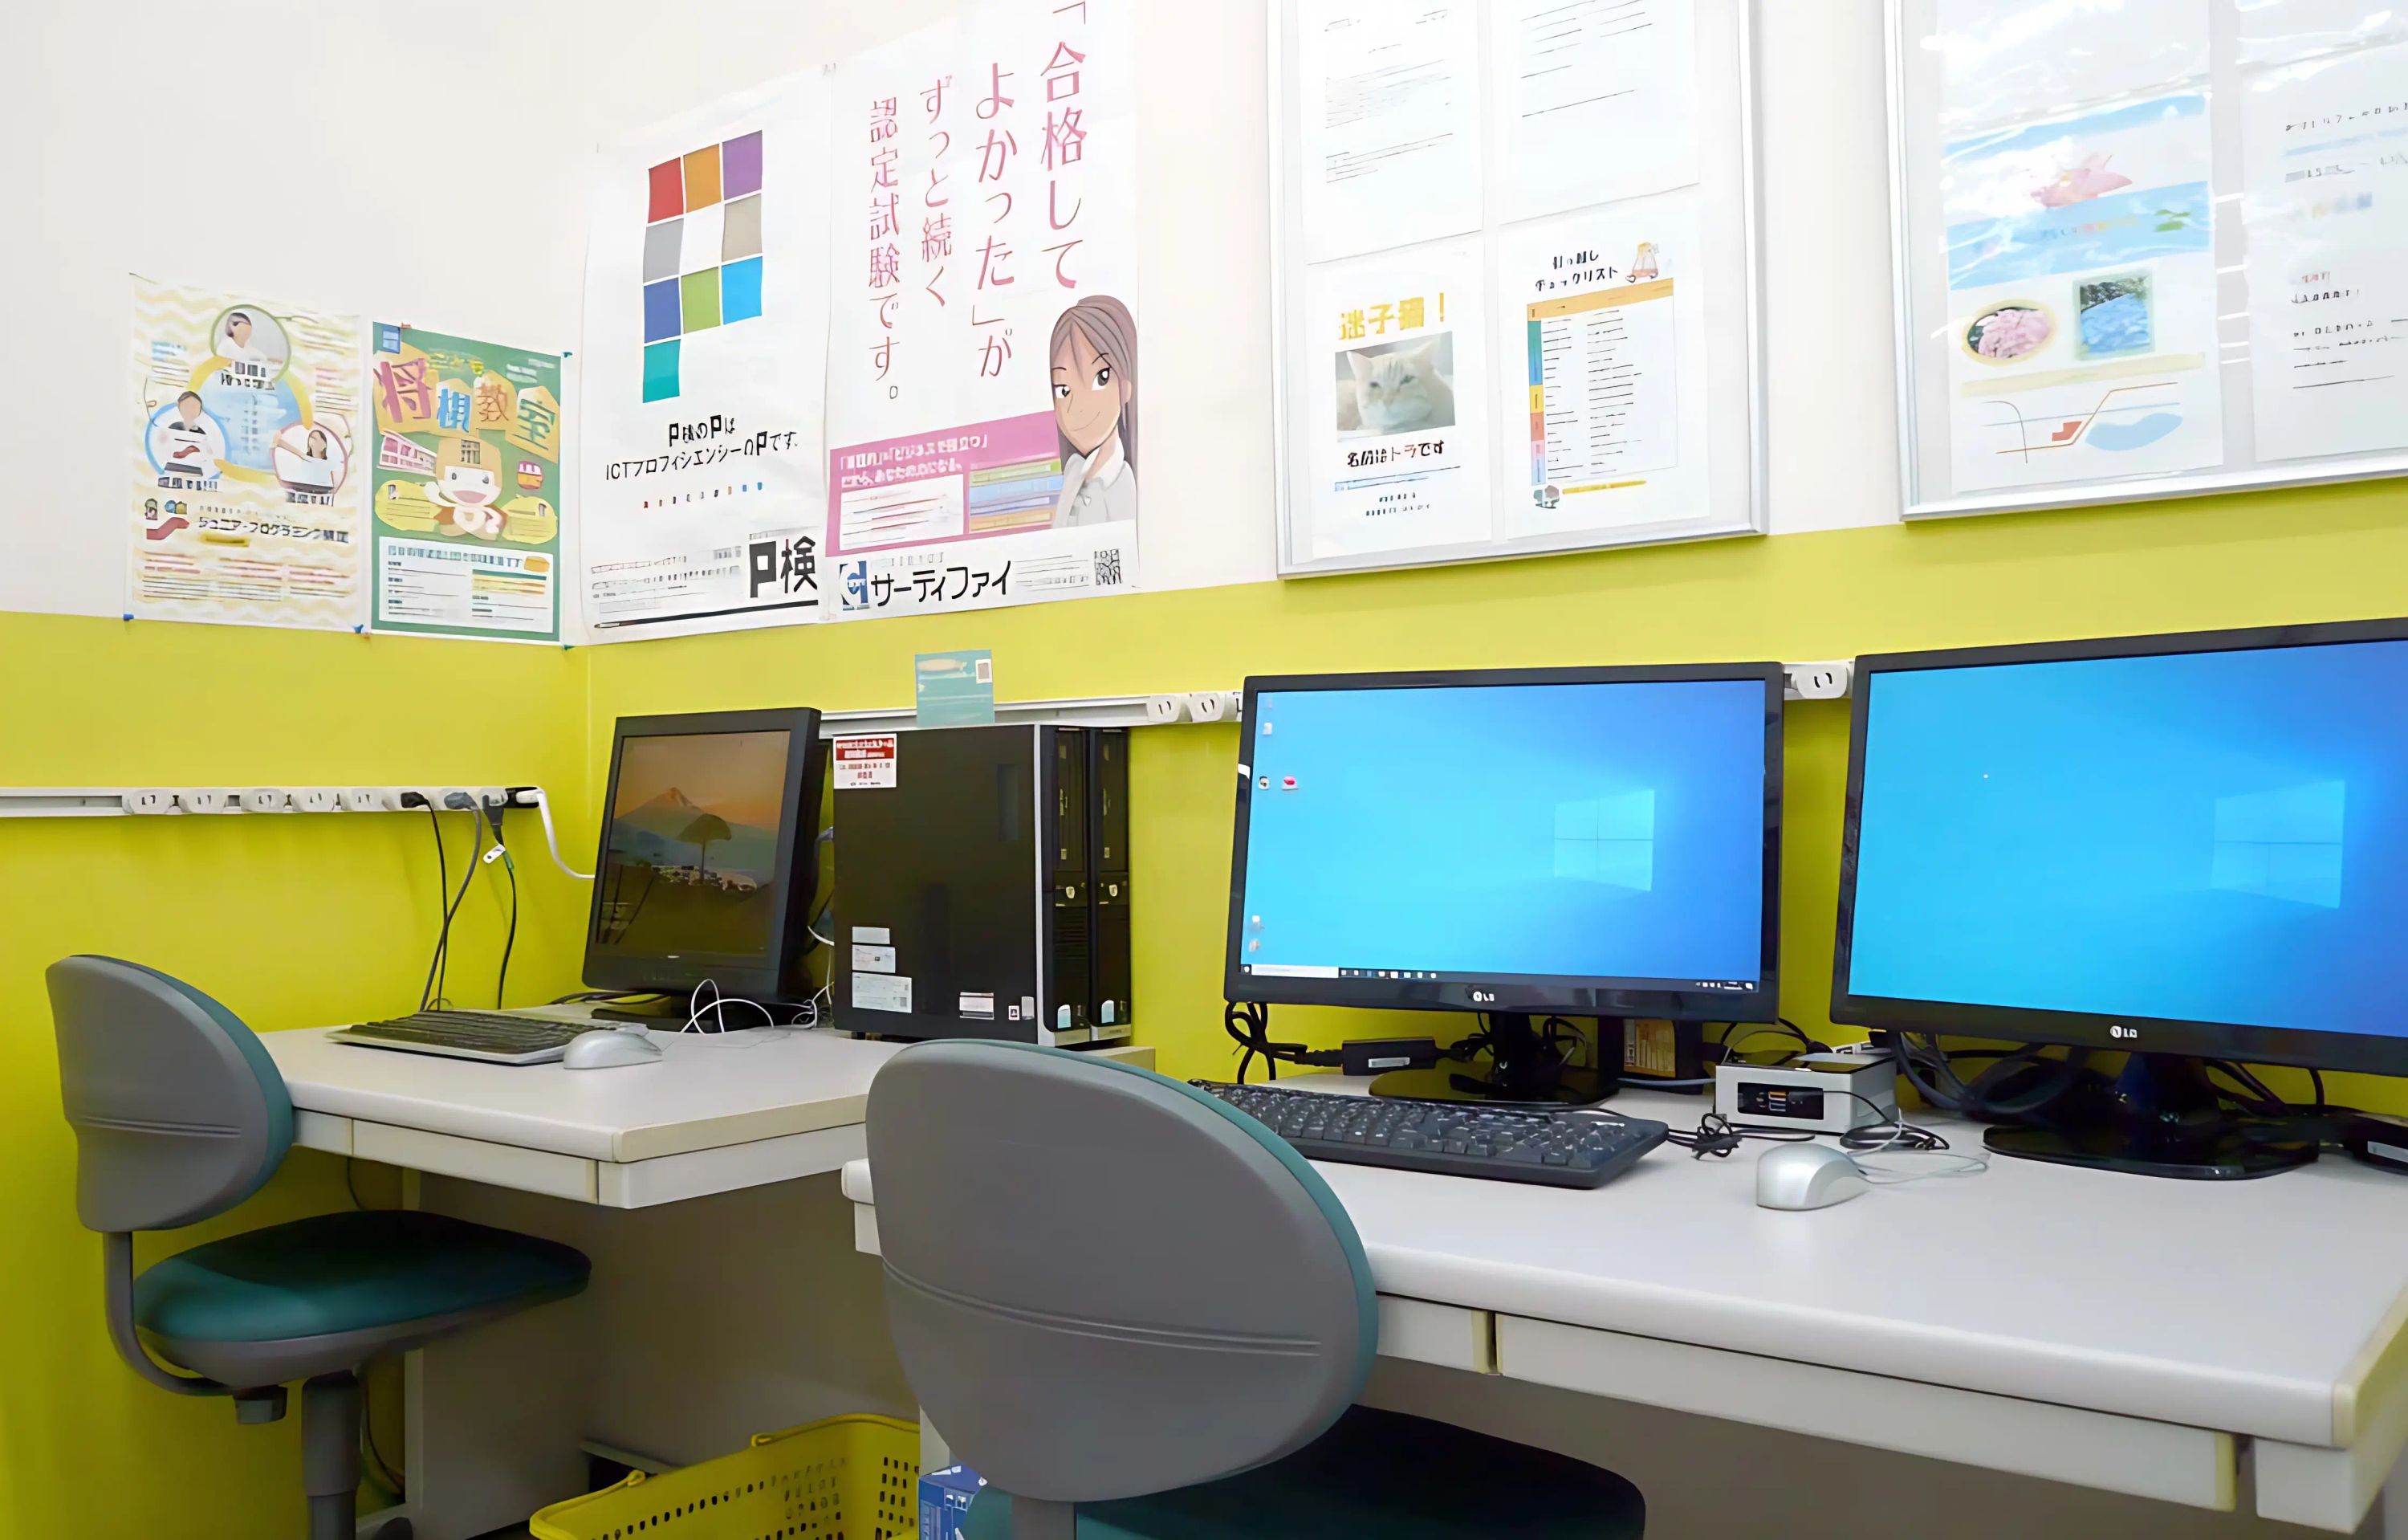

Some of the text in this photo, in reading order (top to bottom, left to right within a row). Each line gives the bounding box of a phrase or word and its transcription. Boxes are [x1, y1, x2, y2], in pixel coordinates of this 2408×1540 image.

[919, 74, 953, 307] ずっと続く
[749, 536, 818, 598] P検
[871, 560, 1011, 607] サーティファイ
